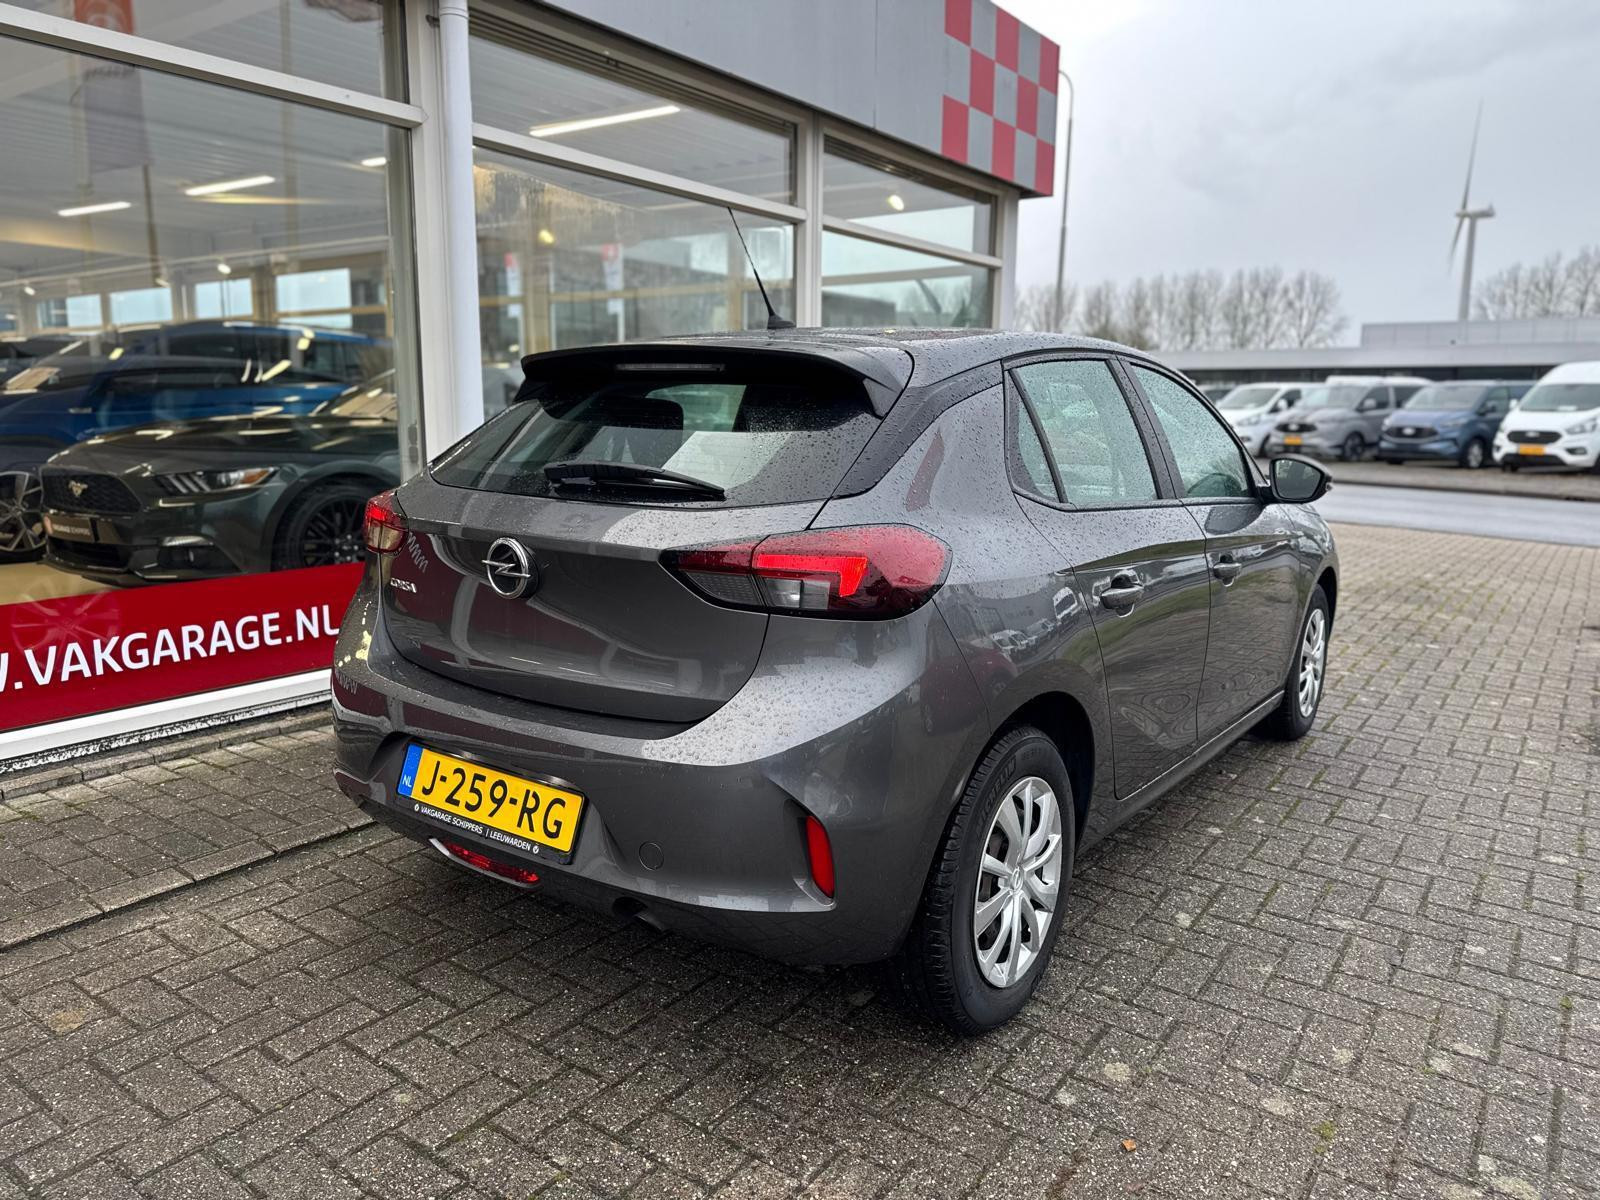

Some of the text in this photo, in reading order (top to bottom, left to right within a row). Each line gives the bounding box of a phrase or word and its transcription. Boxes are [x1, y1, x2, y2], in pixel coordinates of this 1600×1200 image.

[0, 605, 340, 692] .VAKGARAGE.NL
[402, 774, 413, 788] NL
[422, 760, 566, 839] J-259-RG
[420, 806, 531, 851] VAKGARAGE SCHIPPERS LEEUWARDEN
